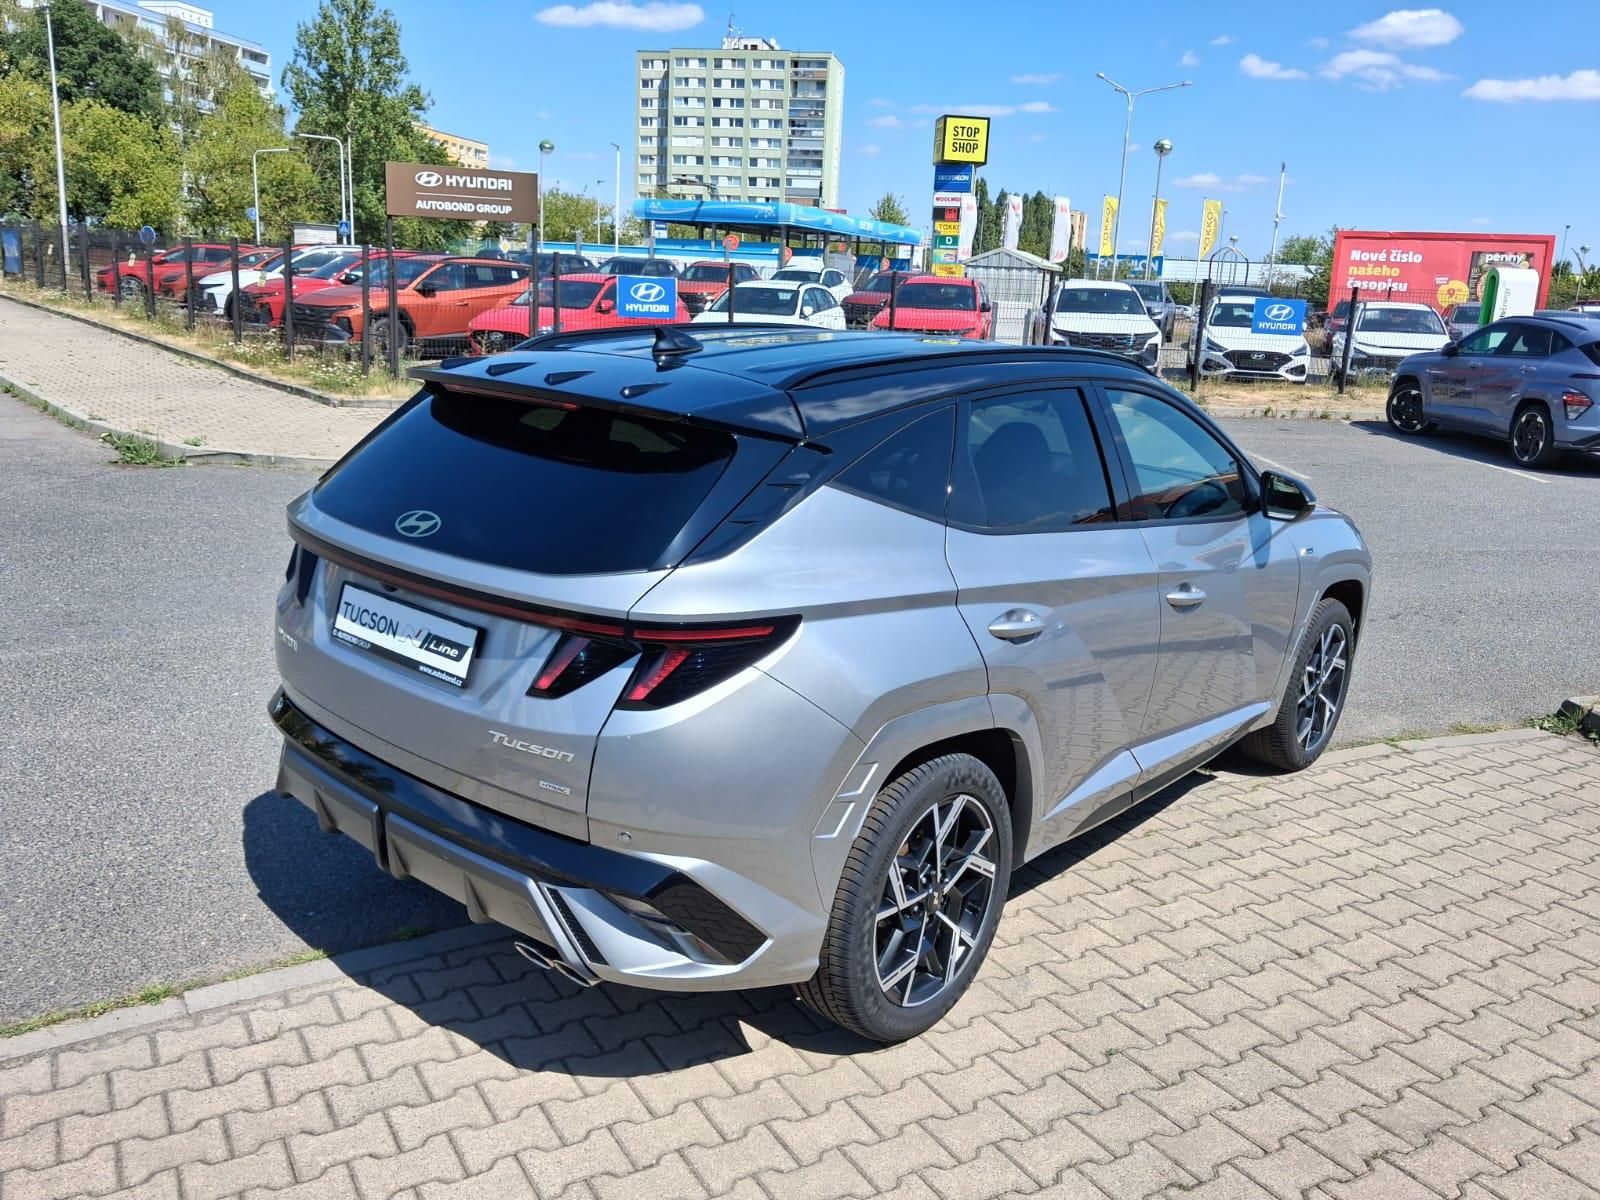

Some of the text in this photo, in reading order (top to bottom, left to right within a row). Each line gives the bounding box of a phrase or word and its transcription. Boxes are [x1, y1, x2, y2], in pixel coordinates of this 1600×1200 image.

[953, 126, 980, 138] STOP
[952, 141, 979, 153] SHOP
[445, 174, 513, 191] HYUNDAI
[415, 199, 513, 215] AUTOBOND GROUP
[1350, 249, 1423, 263] Nové číslo
[1484, 253, 1524, 264] penny
[1348, 264, 1400, 277] našeho
[1346, 277, 1408, 292] časopisu
[625, 303, 670, 313] HYUNDAI
[1258, 321, 1297, 331] HYUNDAI
[343, 600, 400, 639] TUCSON
[429, 639, 460, 658] Line
[419, 664, 463, 687] www.autobond.cz
